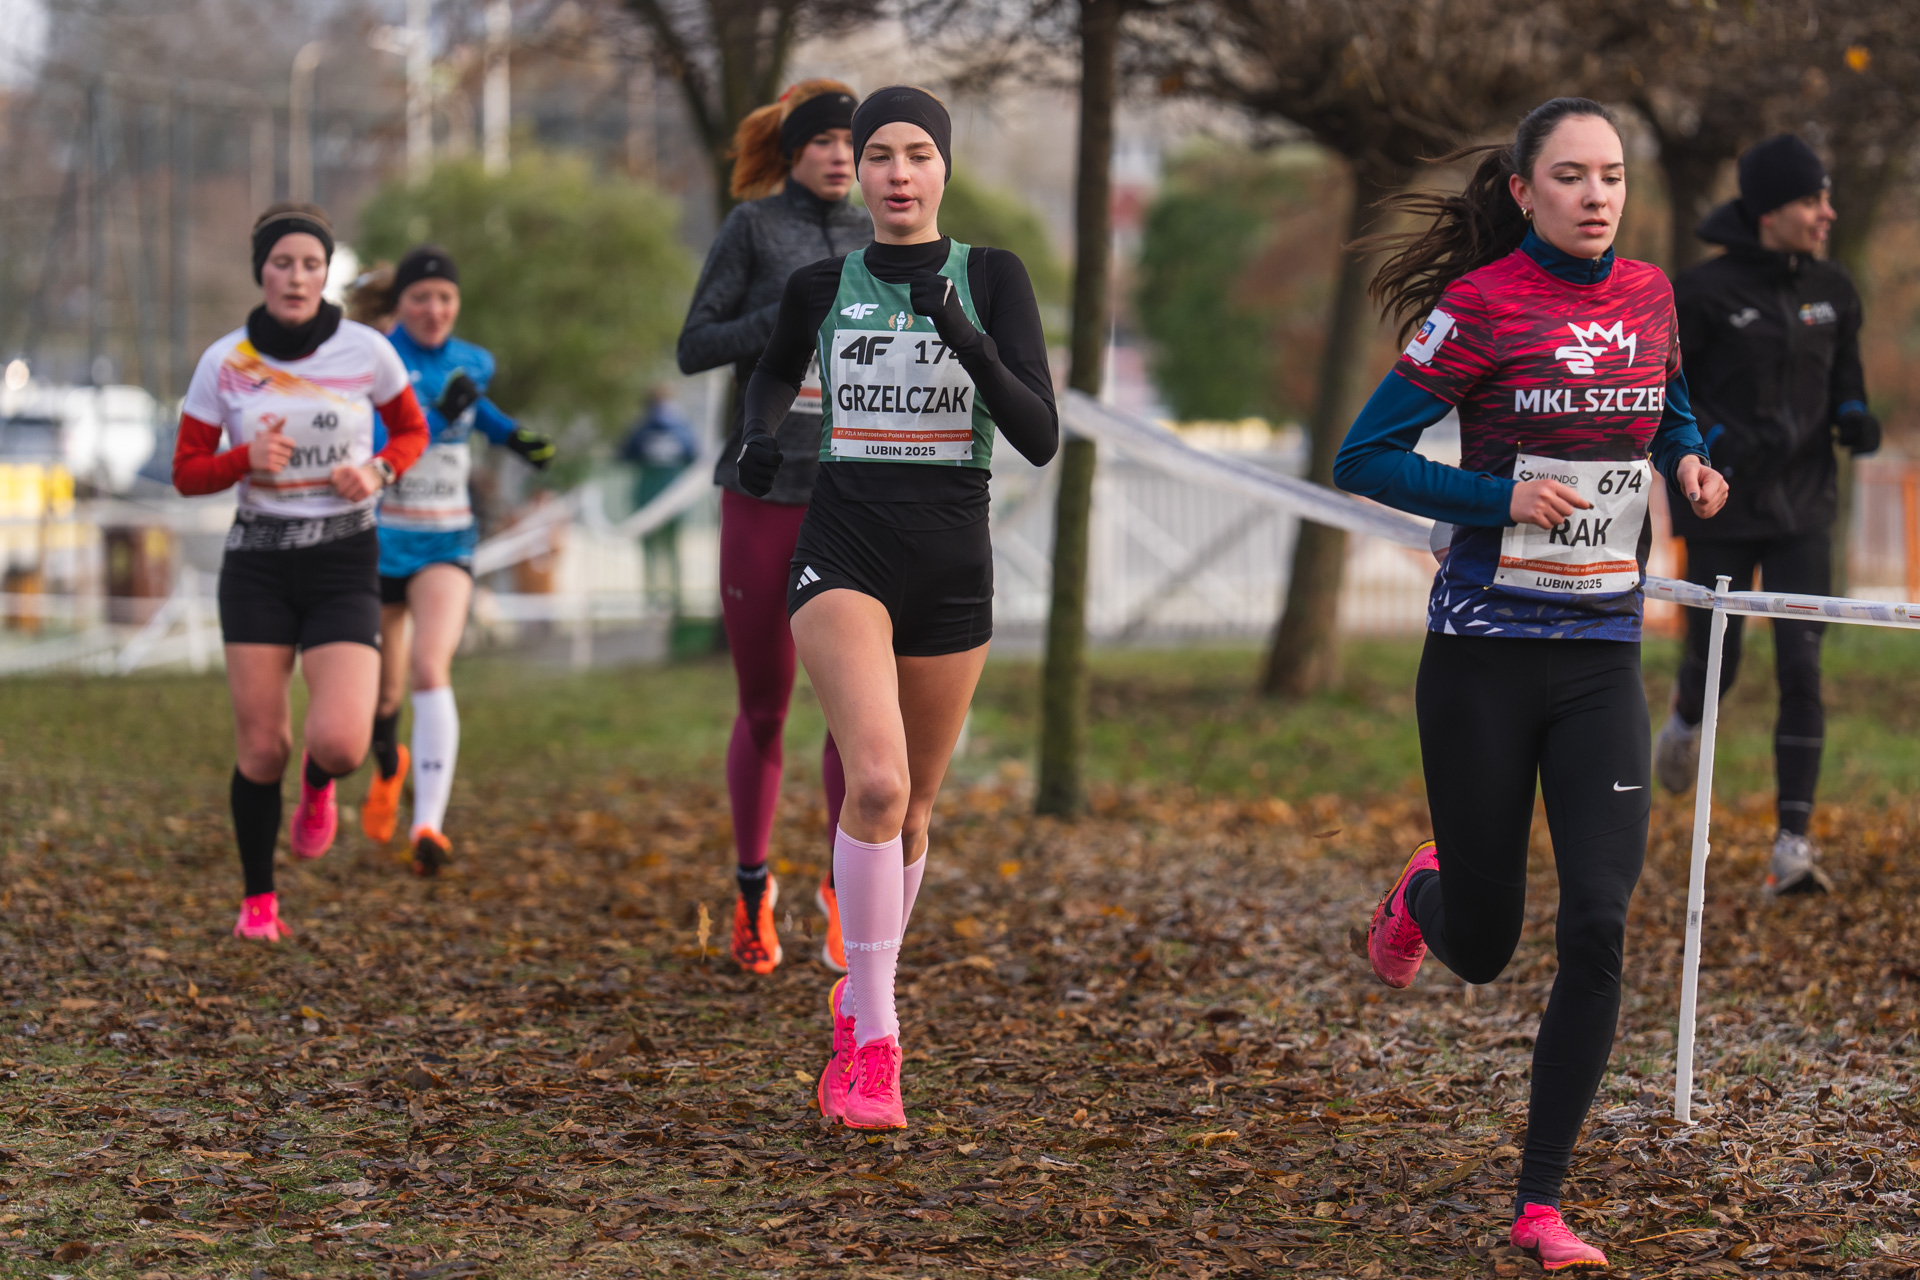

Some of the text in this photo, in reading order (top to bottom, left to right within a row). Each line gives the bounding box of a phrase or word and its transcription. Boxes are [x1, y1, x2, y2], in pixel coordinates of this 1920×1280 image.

[840, 303, 880, 320] 4F
[840, 335, 895, 365] 4F
[837, 384, 969, 414] GRZELCZAK
[1514, 389, 1579, 413] MKL
[312, 412, 338, 430] 40
[865, 445, 936, 456] LUBIN 2025
[1597, 469, 1642, 495] 674
[1549, 518, 1613, 547] RAK
[1536, 576, 1602, 589] LUBIN 2025
